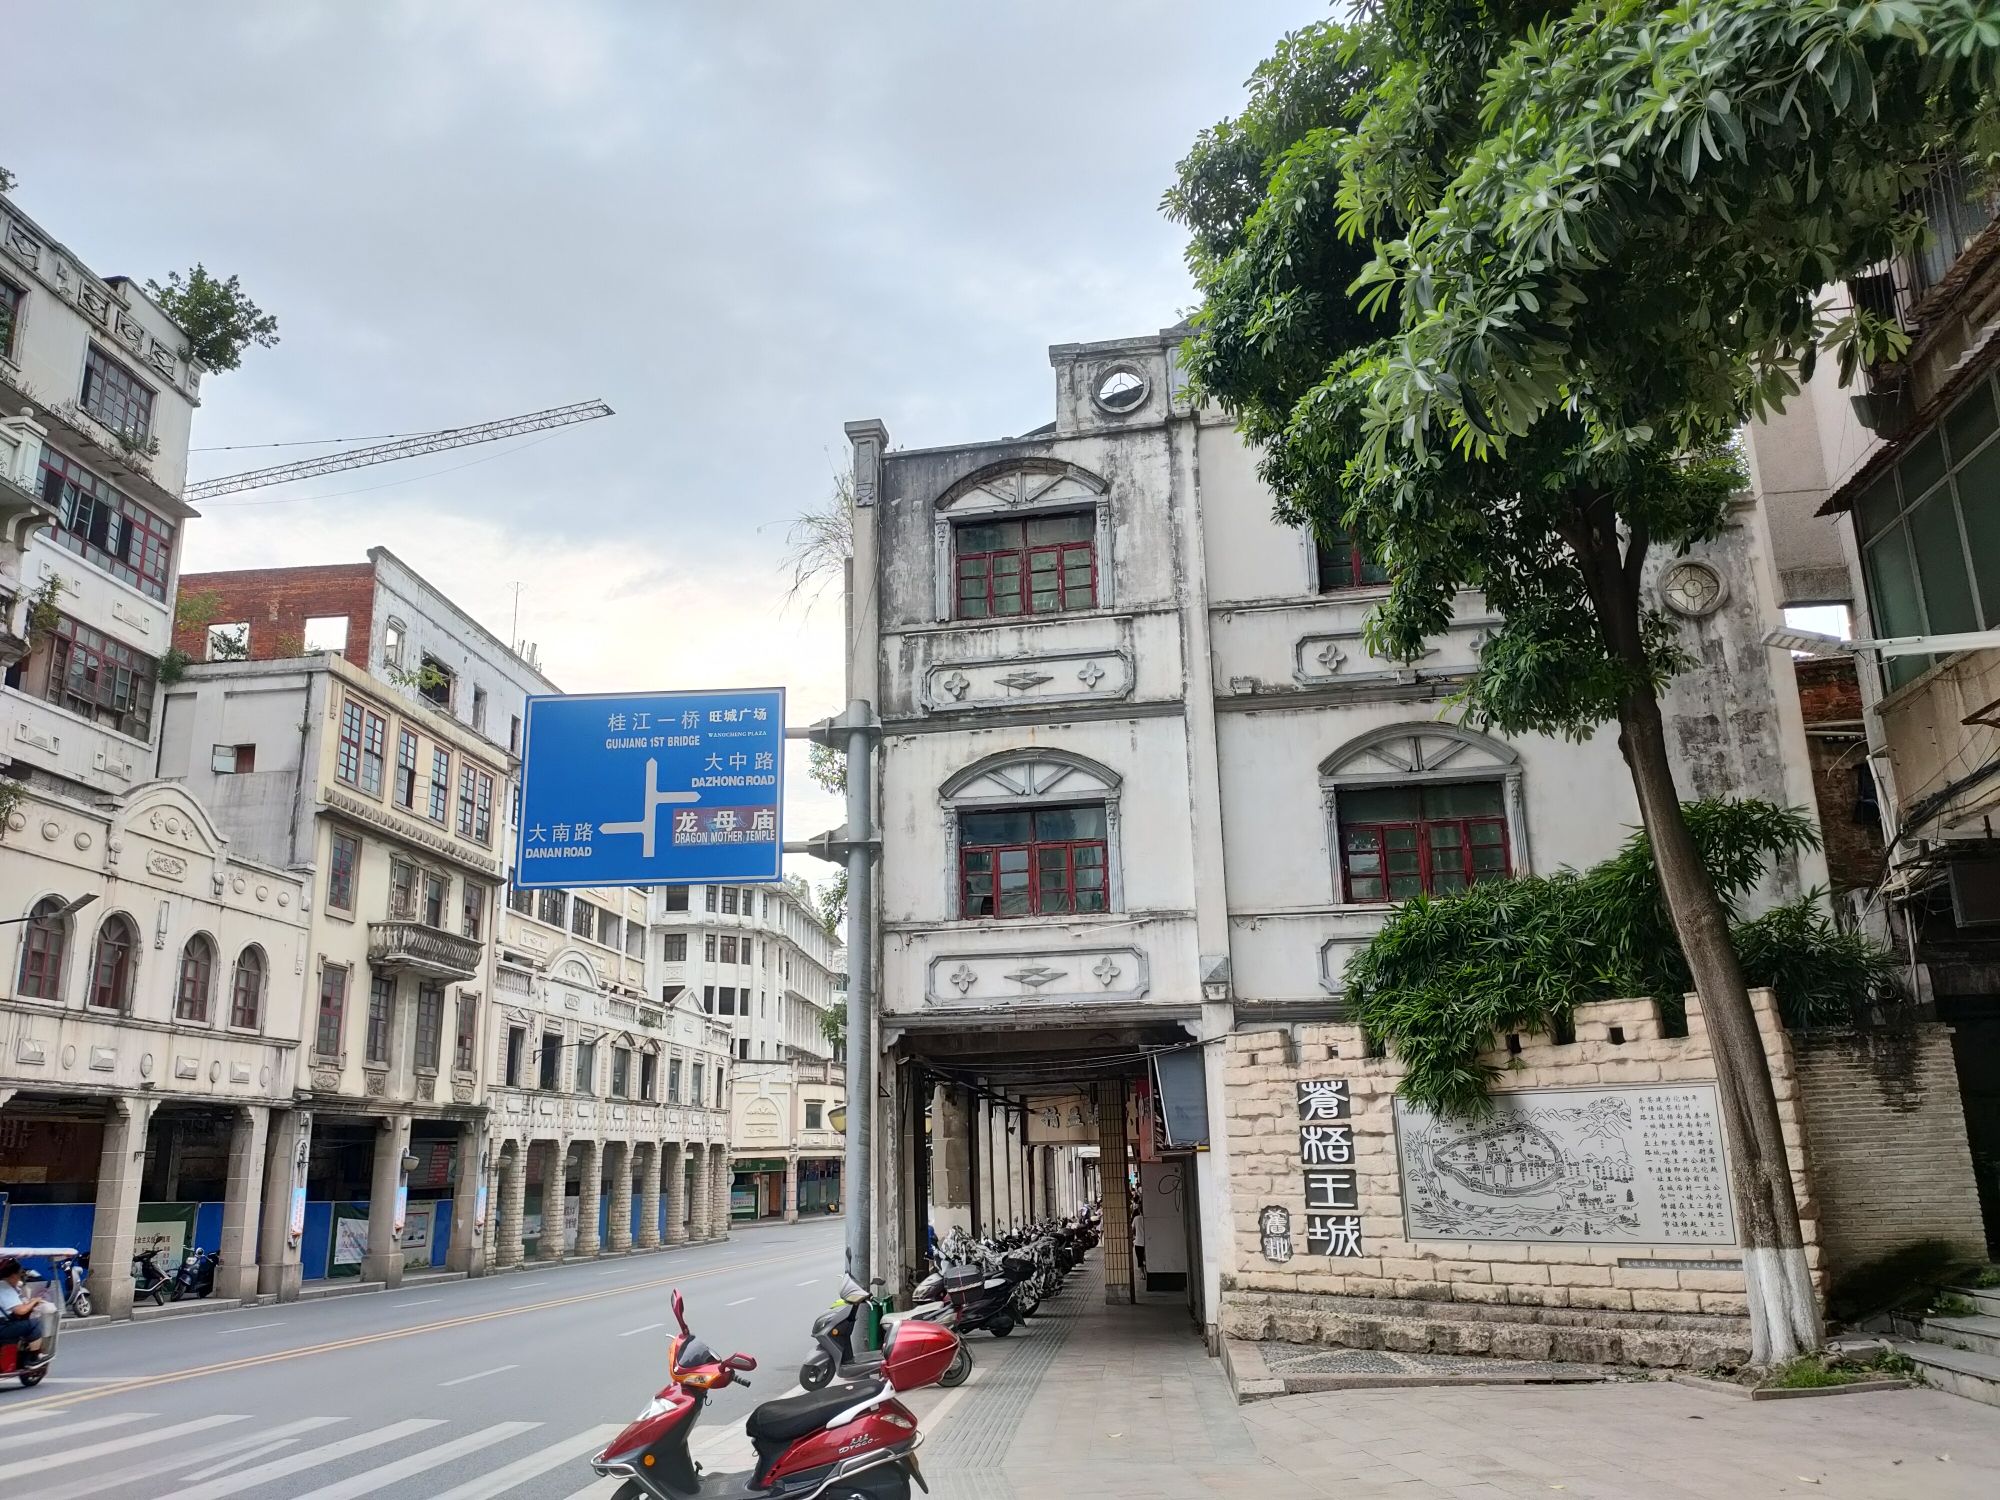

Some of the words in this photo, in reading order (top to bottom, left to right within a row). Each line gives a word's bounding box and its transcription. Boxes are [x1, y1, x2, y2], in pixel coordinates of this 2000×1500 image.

[607, 710, 700, 732] 桂江一桥
[709, 707, 767, 723] 旺城广场
[605, 737, 648, 750] GUIJIANG
[650, 736, 665, 748] 1ST
[667, 735, 700, 747] BRIDGE
[704, 751, 775, 772] 大中路
[691, 776, 744, 788] DAZHONG
[744, 774, 775, 786] ROAD
[675, 808, 775, 833] 龙母庙
[528, 822, 594, 843] 大南路
[675, 832, 708, 844] DRAGON
[711, 830, 743, 843] MOTHER
[746, 829, 775, 841] TEMPLE
[525, 847, 562, 859] DANAN
[563, 846, 592, 858] ROAD
